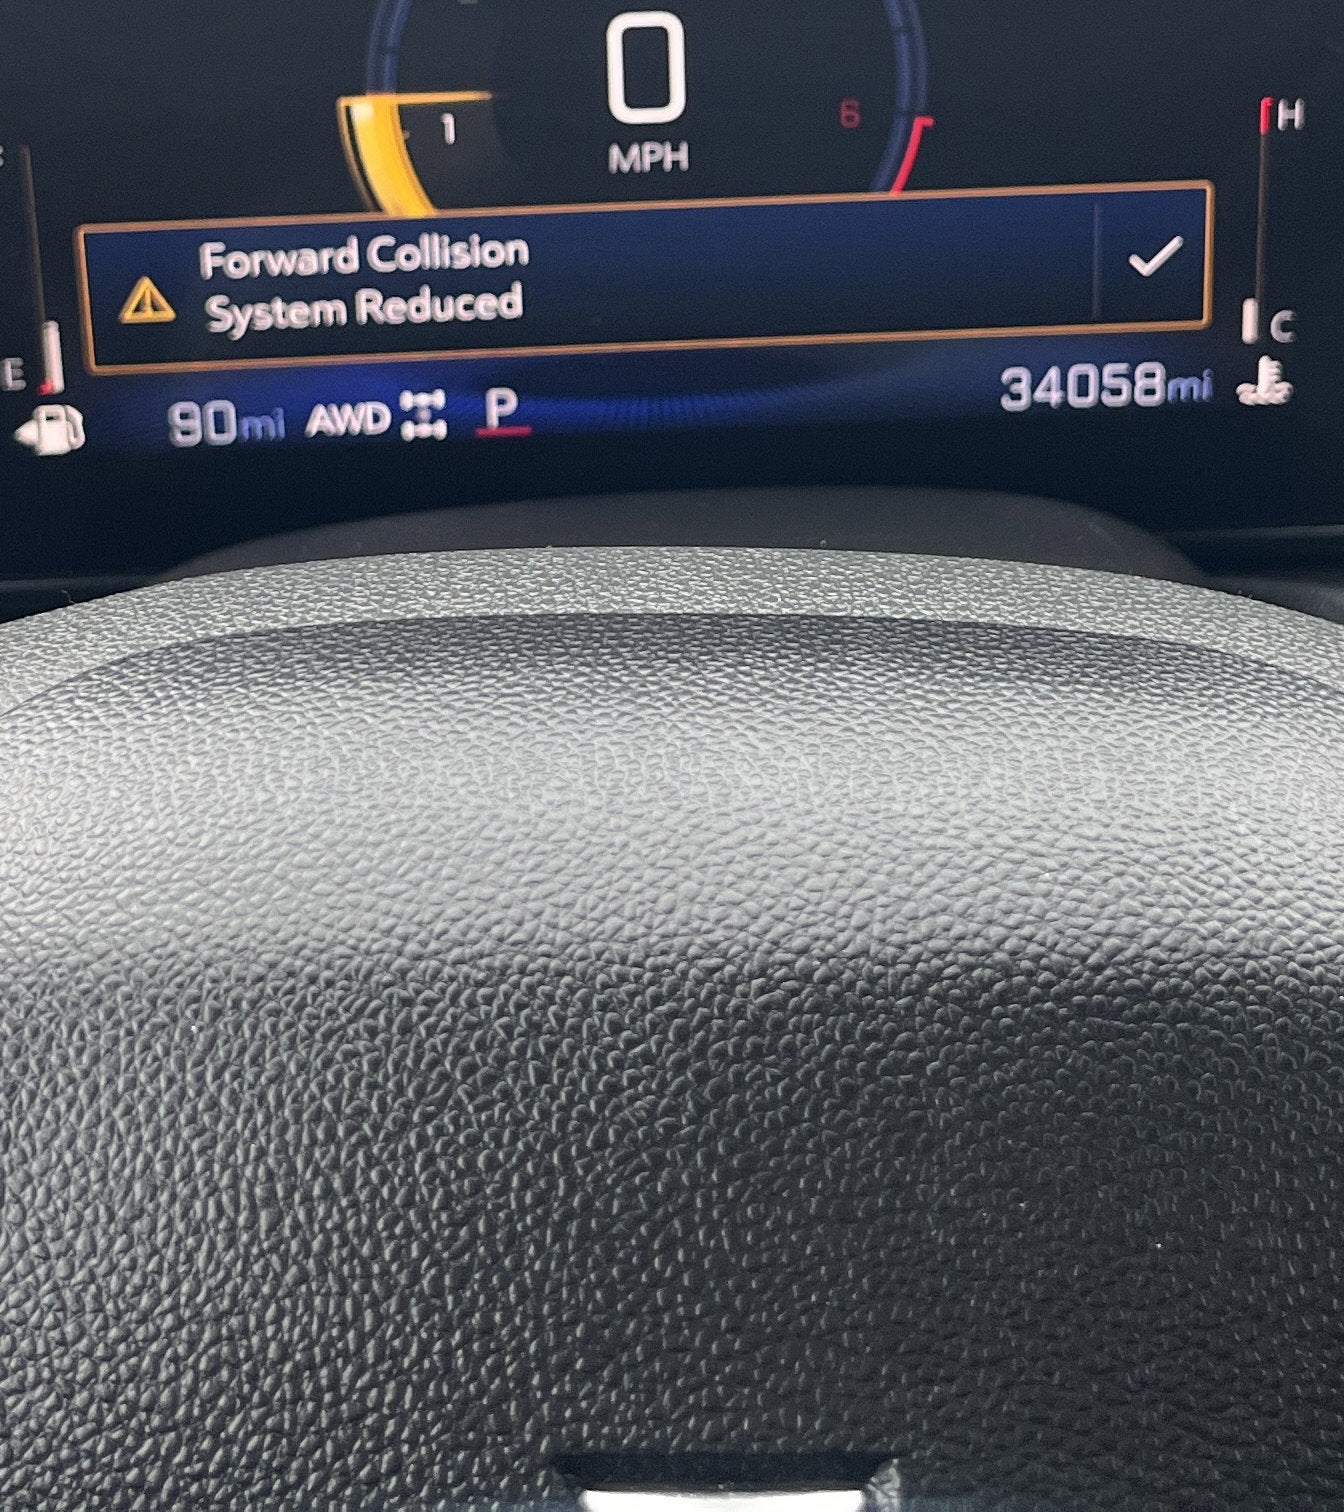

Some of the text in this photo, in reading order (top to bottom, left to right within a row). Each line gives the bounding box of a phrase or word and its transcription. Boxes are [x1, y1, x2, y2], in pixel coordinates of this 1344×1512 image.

[605, 10, 687, 125] 0
[440, 112, 455, 145] 1
[840, 99, 861, 129] 6
[1277, 97, 1305, 131] H
[608, 141, 690, 175] MPH
[199, 232, 530, 281] Forward Collision
[205, 279, 524, 342] System Reduced
[1269, 308, 1298, 344] C
[0, 357, 27, 391] E
[304, 401, 392, 438] AWD
[485, 387, 519, 429] P
